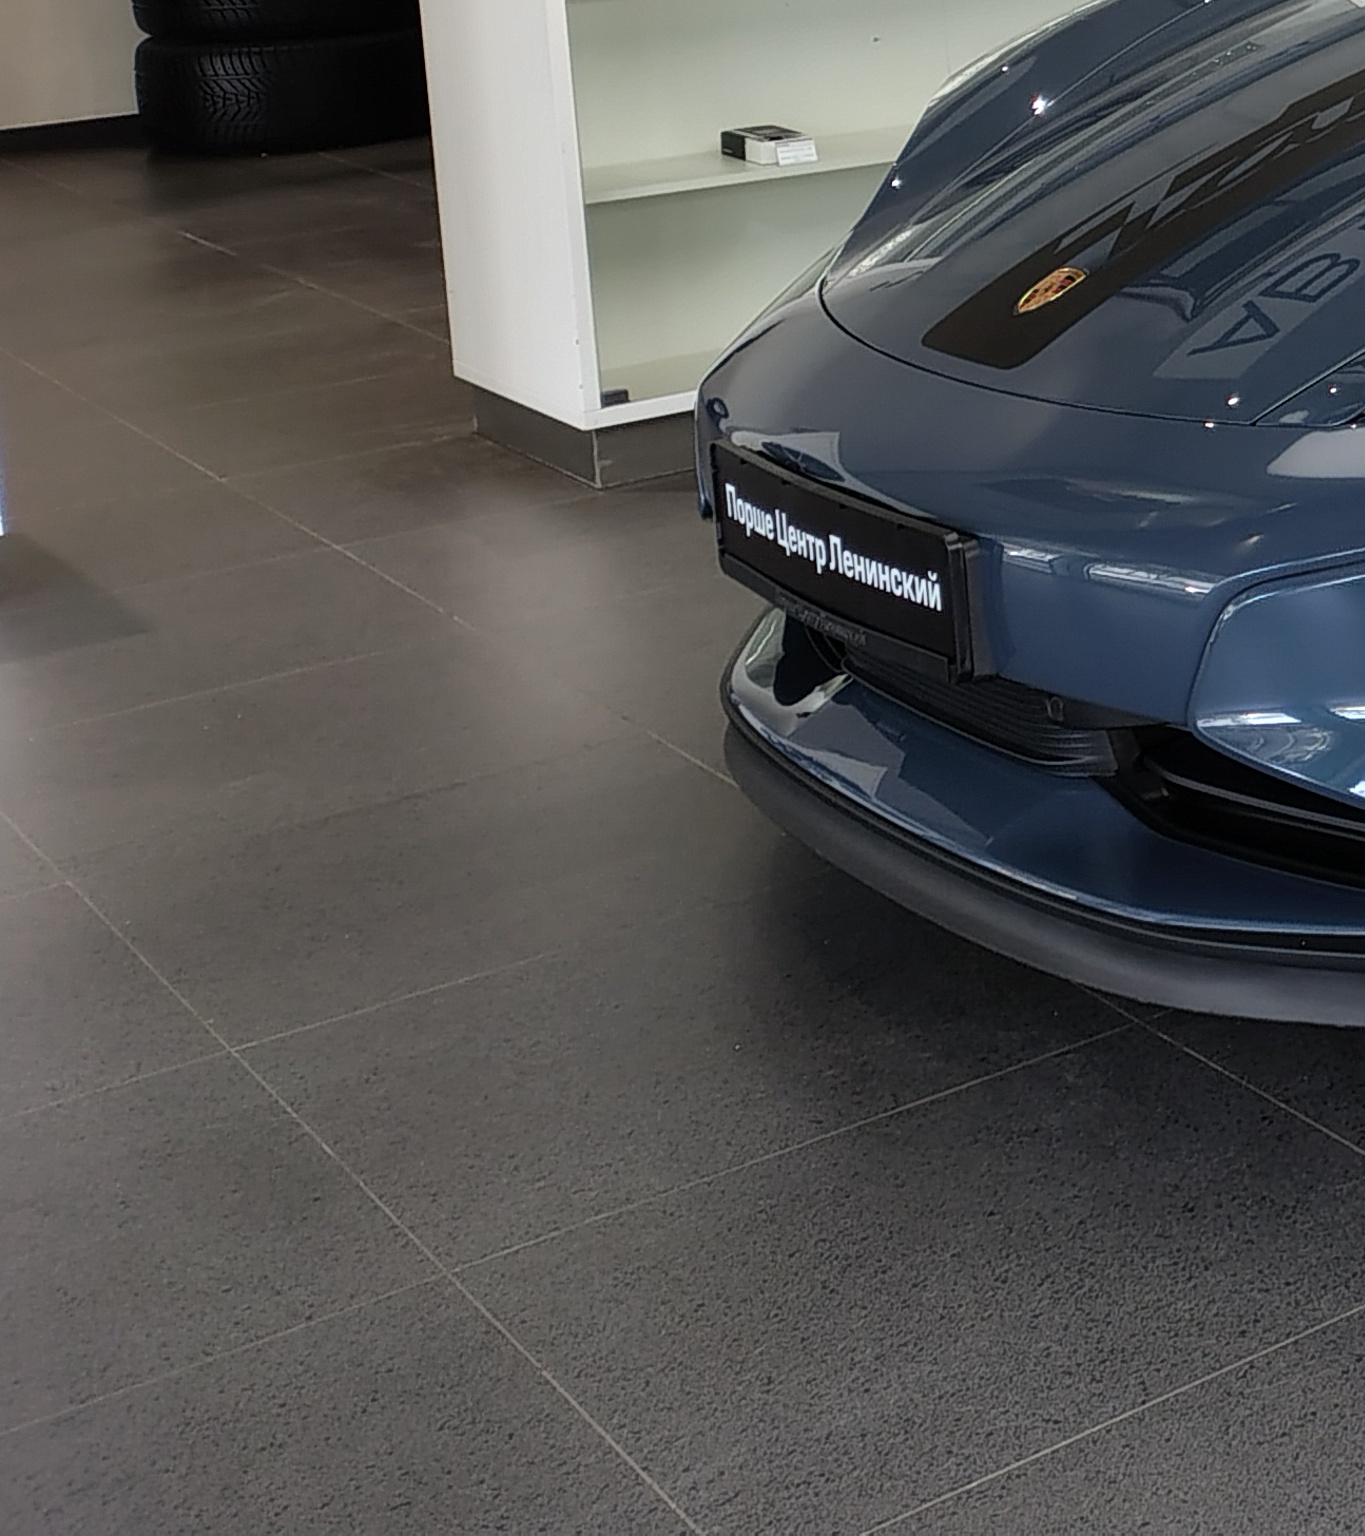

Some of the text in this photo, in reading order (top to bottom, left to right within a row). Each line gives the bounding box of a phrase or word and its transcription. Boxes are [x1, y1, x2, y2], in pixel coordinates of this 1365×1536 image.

[725, 483, 942, 612] Порше Центр Ленинский
